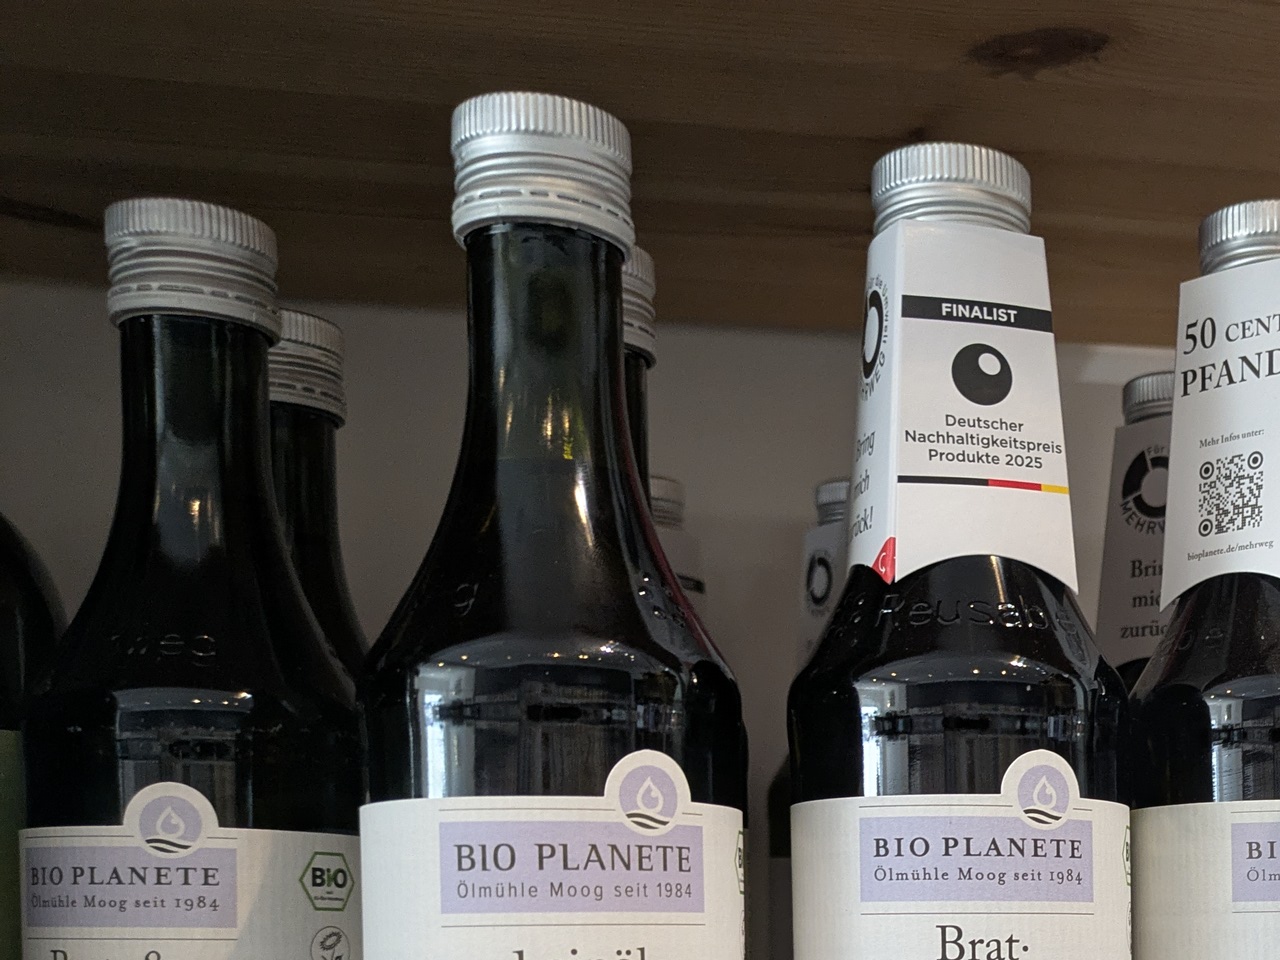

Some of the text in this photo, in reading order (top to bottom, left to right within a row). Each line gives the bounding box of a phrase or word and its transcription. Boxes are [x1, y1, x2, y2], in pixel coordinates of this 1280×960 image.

[941, 303, 1017, 323] FINALIST
[1183, 317, 1216, 355] 50
[945, 414, 1024, 432] Deutscher
[904, 430, 1062, 454] Nachhaltigkeitspreis
[1199, 429, 1264, 448] Mehr Infos unter:
[928, 449, 1043, 469] Produkte 2025
[1187, 539, 1274, 562] bioplanete.de/mehrweg
[454, 843, 692, 873] BIO PLANETE
[873, 837, 1083, 859] BIO PLANETE
[30, 867, 220, 887] BIO PLANETE
[874, 865, 1083, 885] Ölmühle Moog seit 1984
[457, 880, 692, 901] Ölmühle Moog seit 1984
[31, 894, 220, 912] Ölmühle Moog seit 1984
